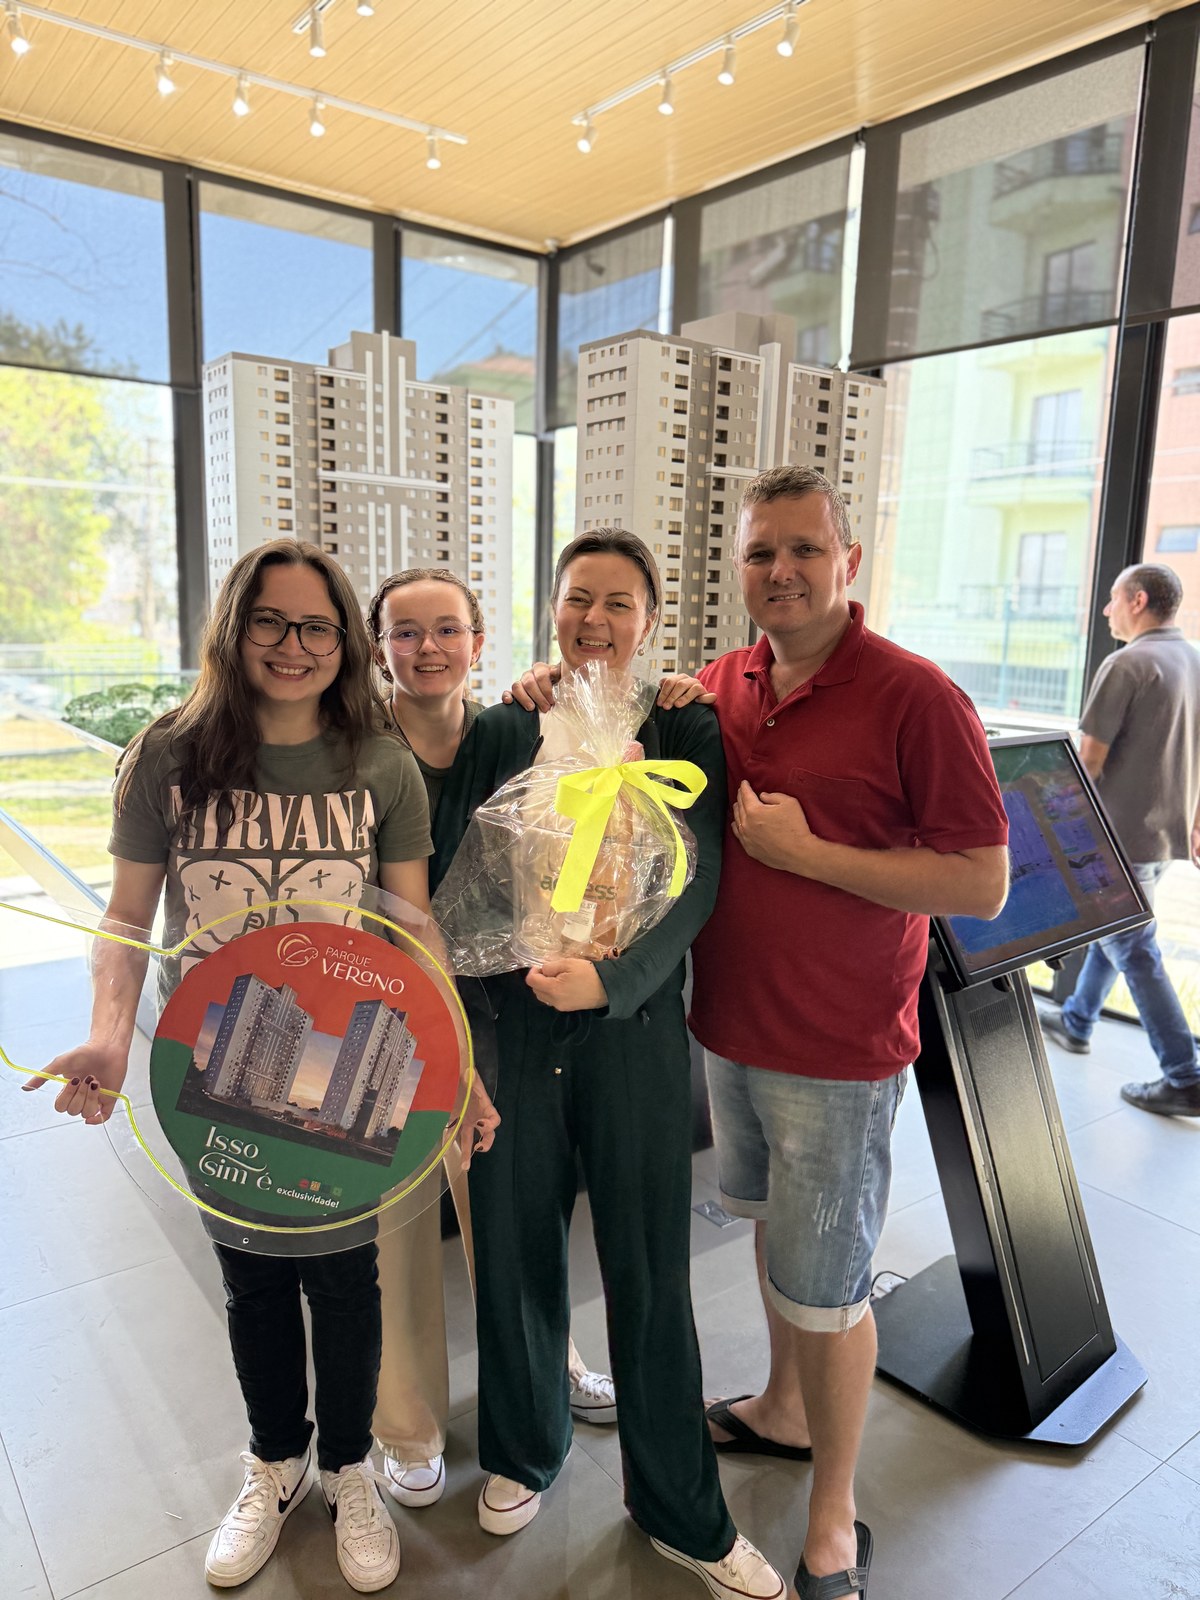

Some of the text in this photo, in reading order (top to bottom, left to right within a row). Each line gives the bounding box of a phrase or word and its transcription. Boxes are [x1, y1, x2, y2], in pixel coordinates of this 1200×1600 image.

[541, 876, 617, 900] aess
[326, 947, 372, 967] PARQUE
[205, 1125, 259, 1158] Isso
[199, 1152, 340, 1208] sim é exclusividade!
